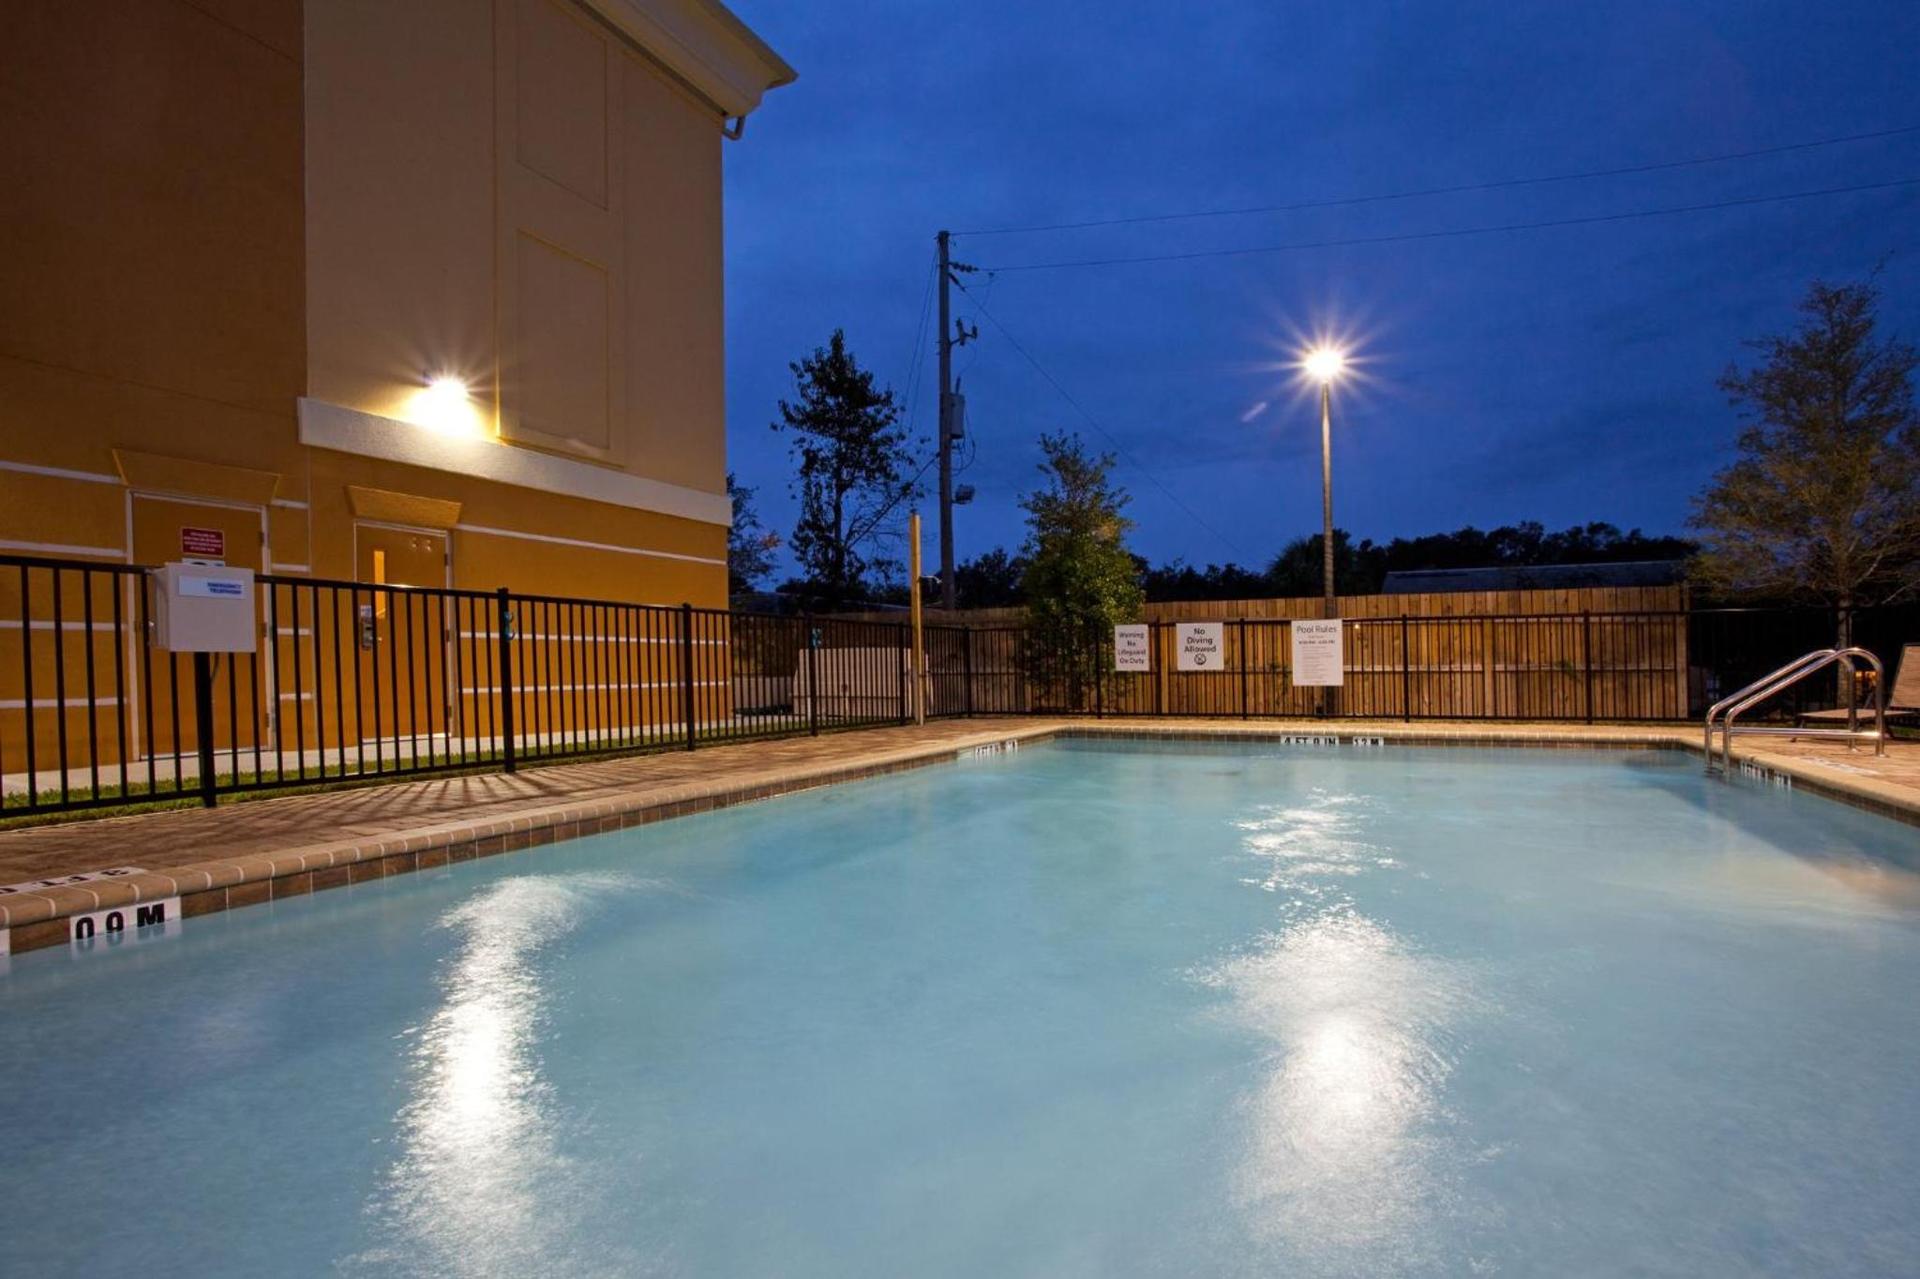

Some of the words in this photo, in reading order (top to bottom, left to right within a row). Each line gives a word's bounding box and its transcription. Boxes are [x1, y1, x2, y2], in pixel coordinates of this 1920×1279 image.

[1296, 625, 1314, 634] Pool
[1315, 625, 1337, 633] Rules
[1186, 636, 1213, 646] Diving
[1184, 645, 1217, 653] Allowed
